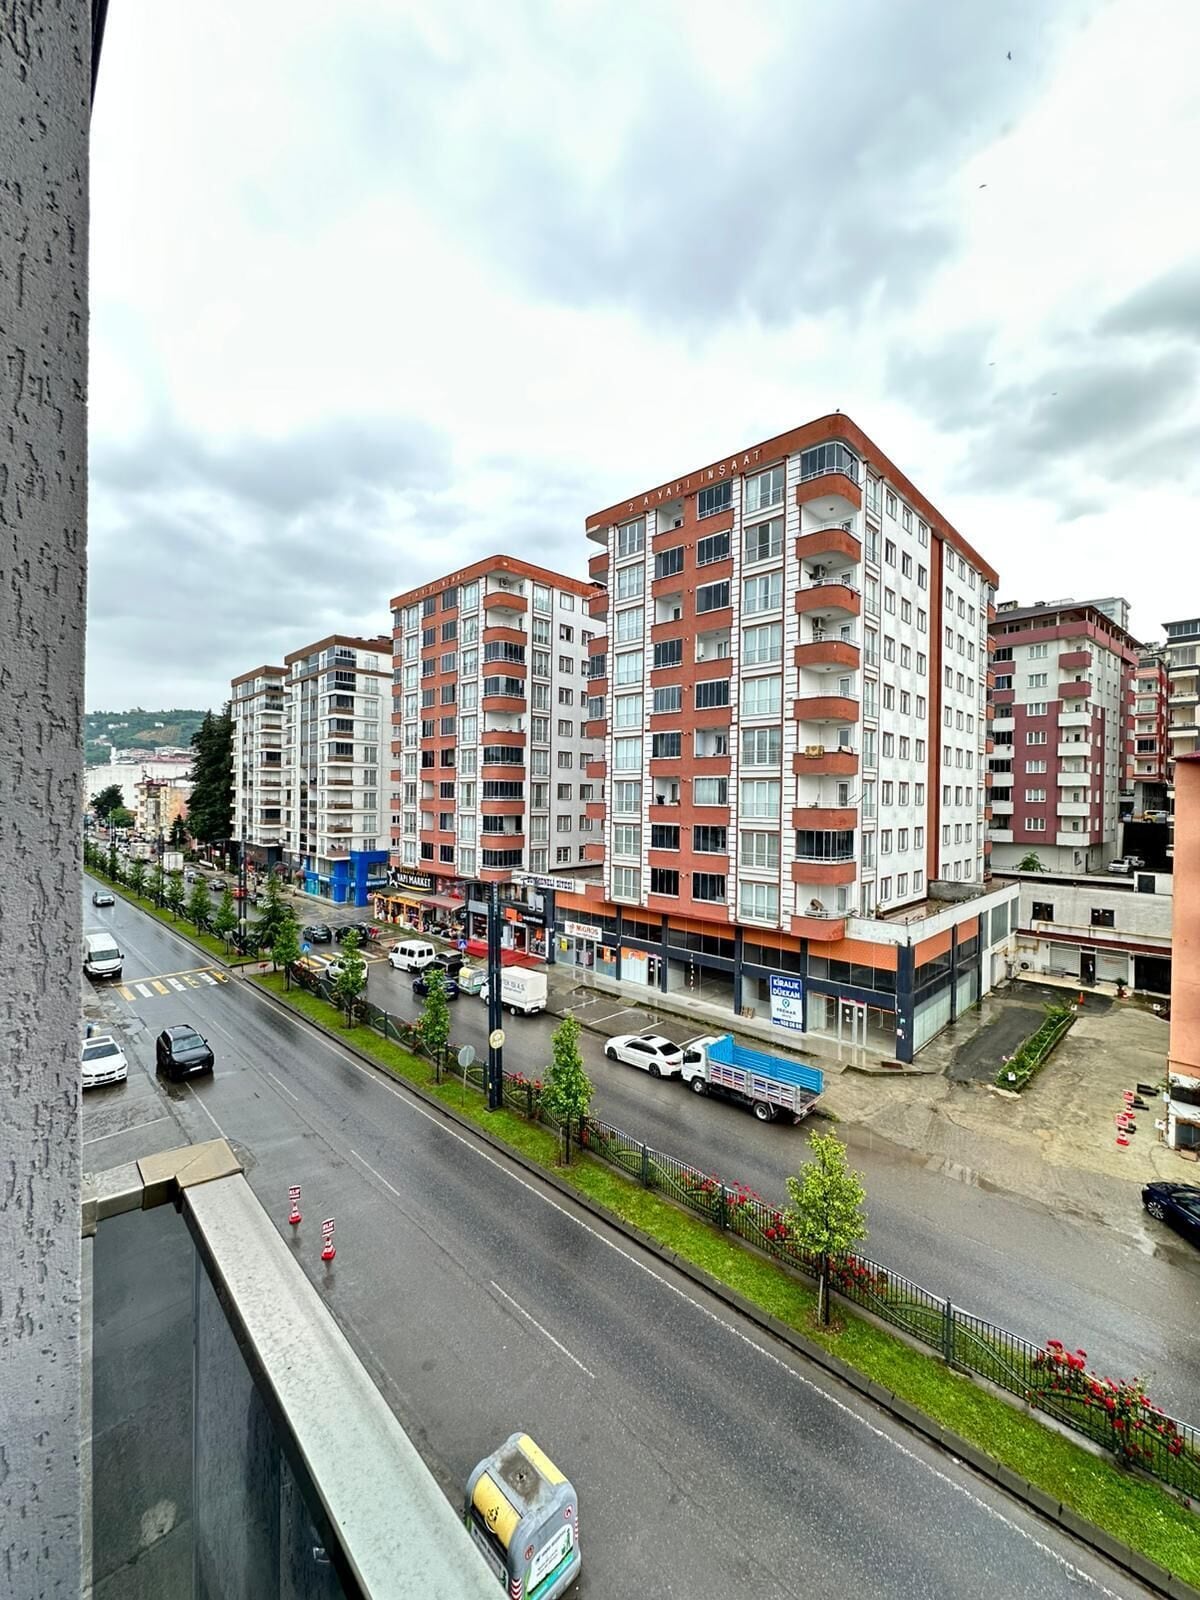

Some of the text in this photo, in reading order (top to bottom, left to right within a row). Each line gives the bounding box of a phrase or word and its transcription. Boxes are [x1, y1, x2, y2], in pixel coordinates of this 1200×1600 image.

[657, 479, 690, 500] YAPI
[409, 875, 431, 888] MARKET
[773, 977, 799, 989] KİRALIK
[773, 987, 800, 998] DÜKKAN
